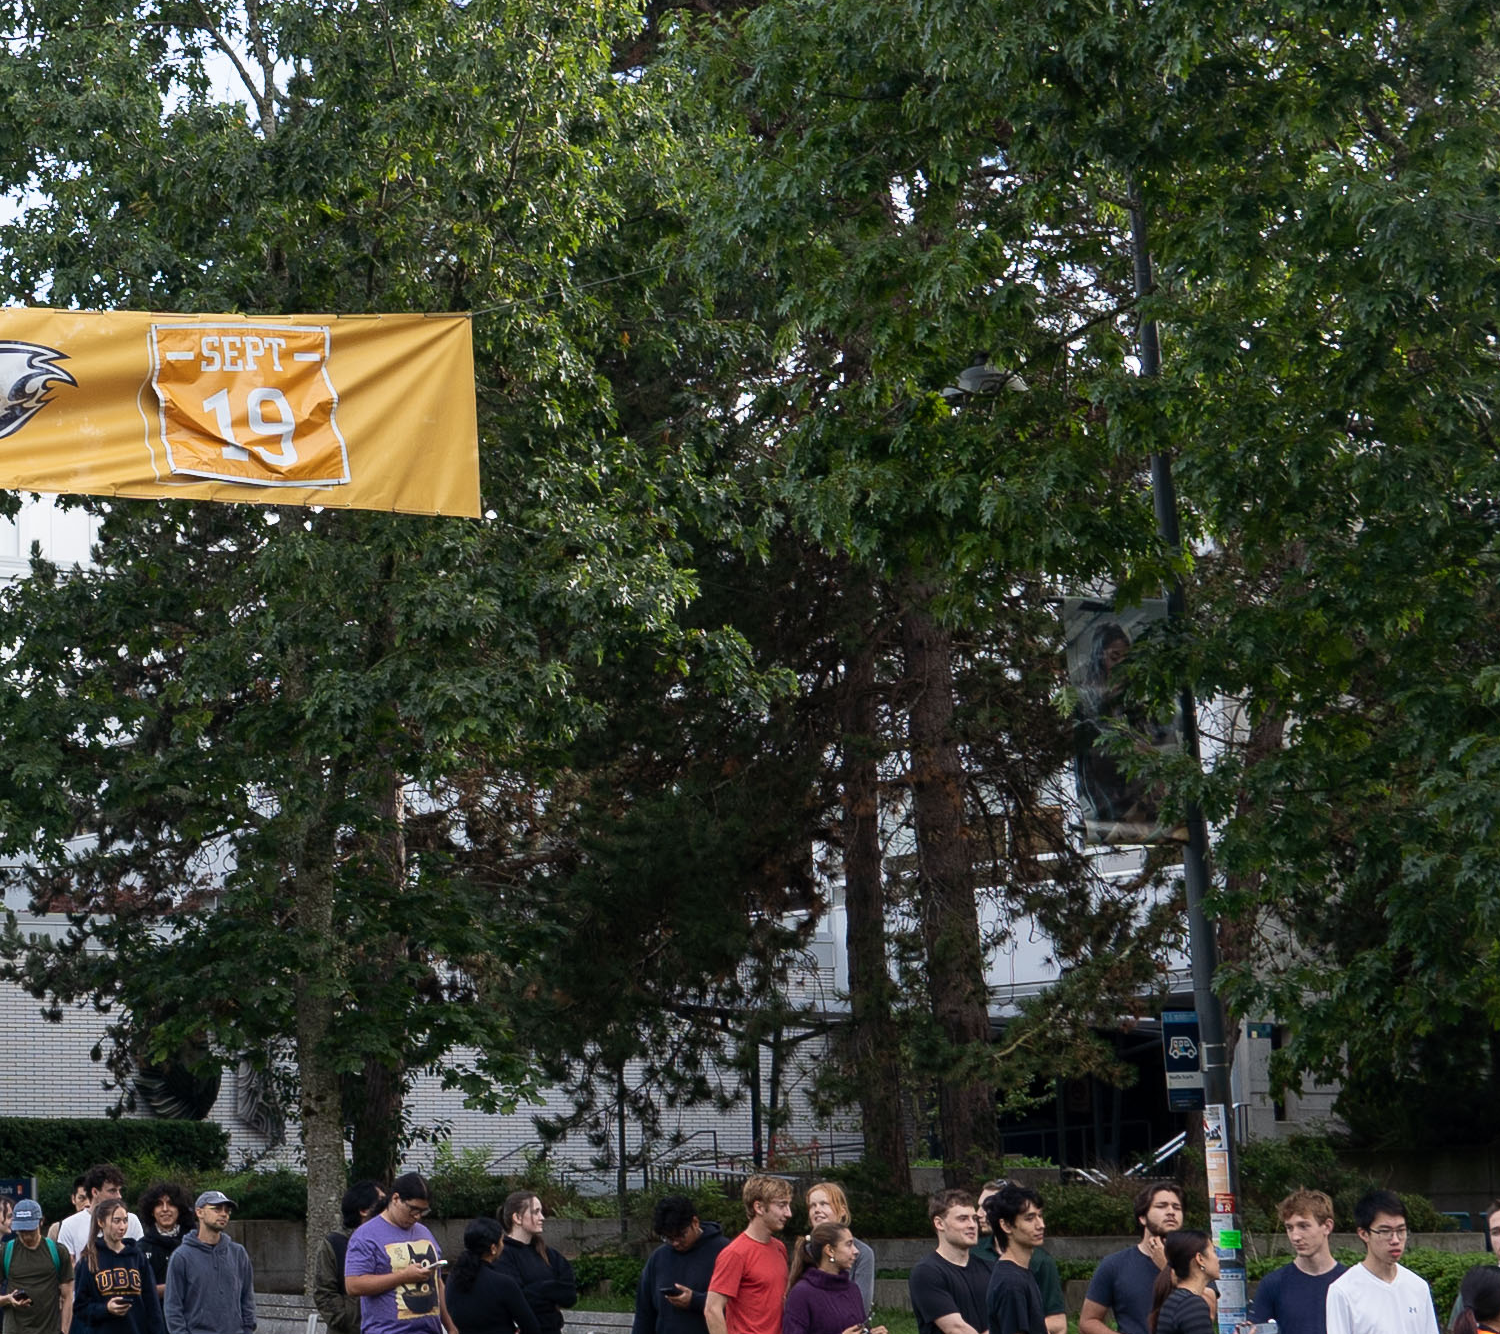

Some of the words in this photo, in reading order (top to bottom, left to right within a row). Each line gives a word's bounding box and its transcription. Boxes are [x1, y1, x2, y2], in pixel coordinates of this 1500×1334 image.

[200, 335, 287, 372] SEPT
[202, 387, 299, 467] 19
[95, 1267, 141, 1292] UBC
